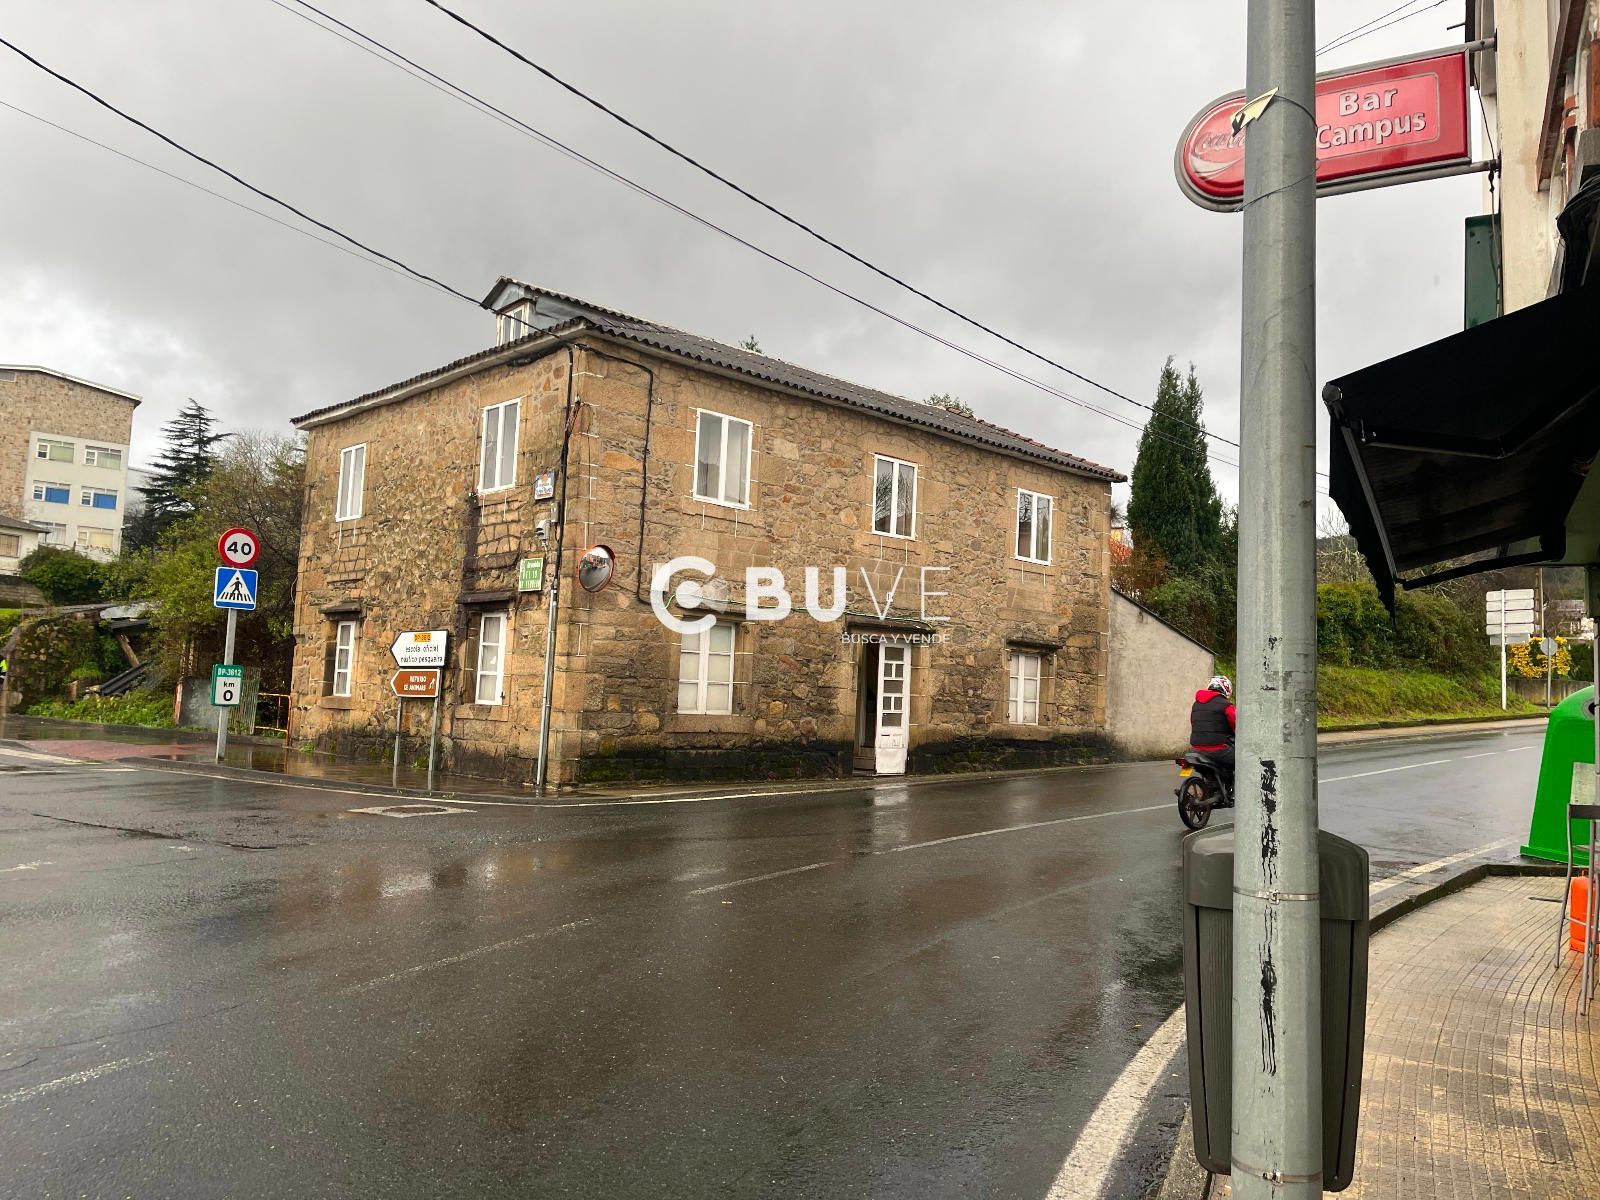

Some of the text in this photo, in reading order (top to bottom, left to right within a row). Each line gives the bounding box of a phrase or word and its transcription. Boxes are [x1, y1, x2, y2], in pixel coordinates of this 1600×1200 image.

[1339, 88, 1398, 116] Bar
[1316, 111, 1427, 149] Campus
[227, 541, 252, 556] 40
[223, 680, 235, 688] km
[223, 689, 234, 702] 0
